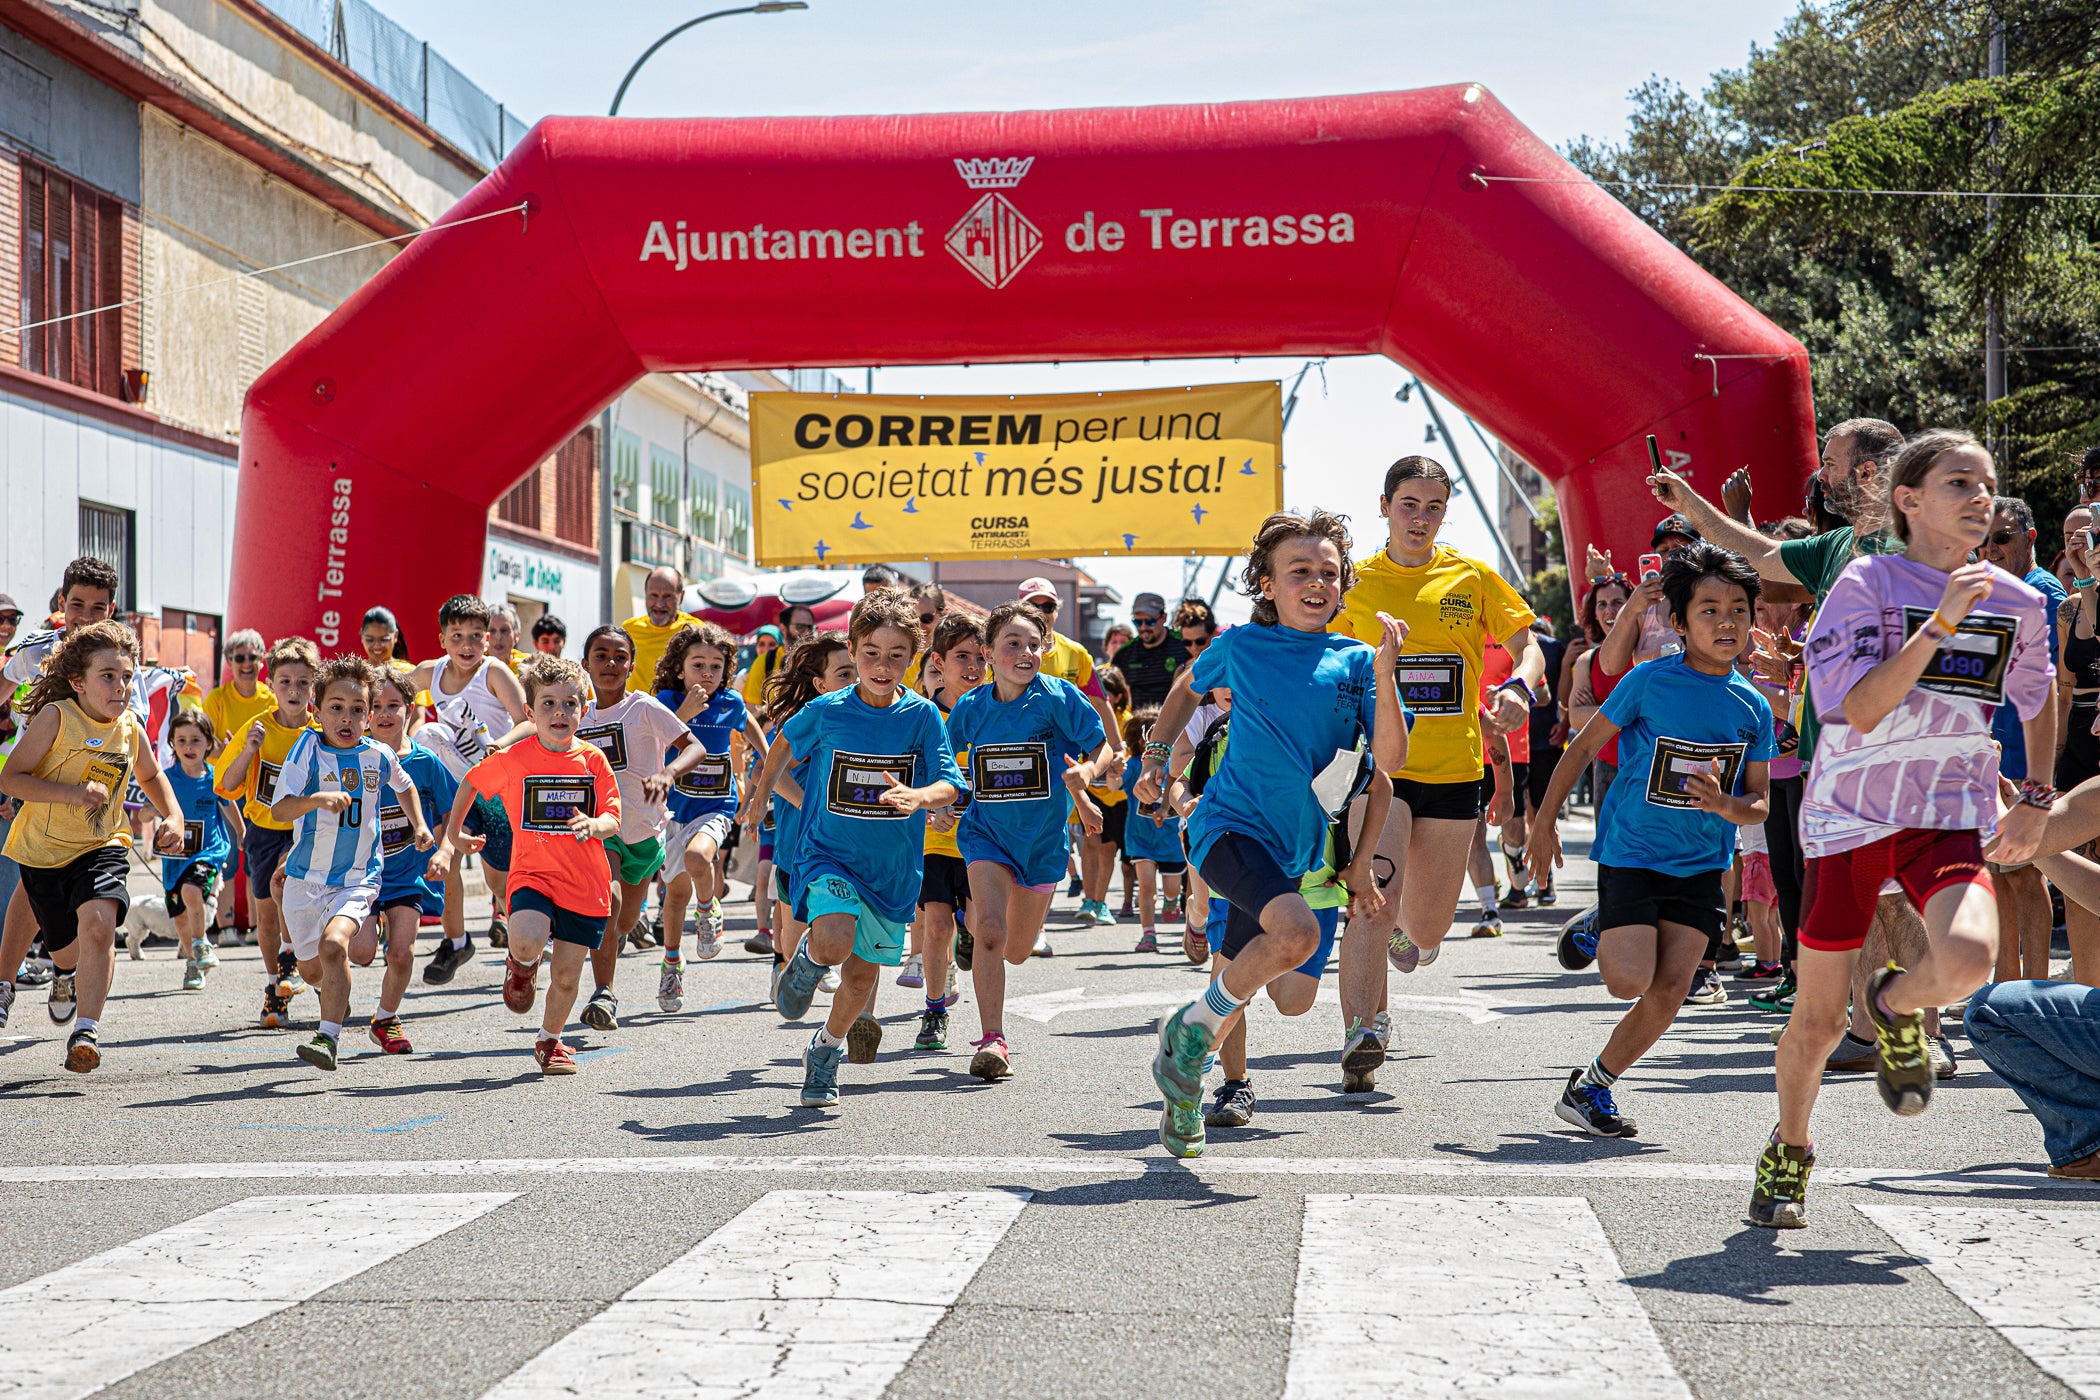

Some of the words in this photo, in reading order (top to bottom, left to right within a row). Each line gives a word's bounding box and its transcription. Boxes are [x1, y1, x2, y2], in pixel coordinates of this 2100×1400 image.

[640, 219, 924, 271] Ajuntament
[1065, 211, 1126, 254] de
[1140, 207, 1356, 251] Terrassa
[794, 413, 1042, 450] CORREM
[1054, 416, 1128, 451] per
[1138, 411, 1222, 442] una
[797, 460, 973, 501] societat
[985, 456, 1084, 497] més
[1091, 456, 1226, 503] justa!
[970, 516, 1029, 530] CURSA
[318, 478, 353, 603] Terrassa
[970, 538, 1031, 550] TERRASSA
[1439, 597, 1473, 609] CURSA
[315, 610, 342, 648] de
[1407, 685, 1441, 700] 436
[1675, 744, 1694, 752] CURSA
[90, 765, 115, 779] Correm
[852, 772, 871, 784] Nil
[692, 776, 716, 786] 244
[993, 773, 1025, 787] 206
[545, 805, 575, 818] 593
[383, 831, 402, 843] 32
